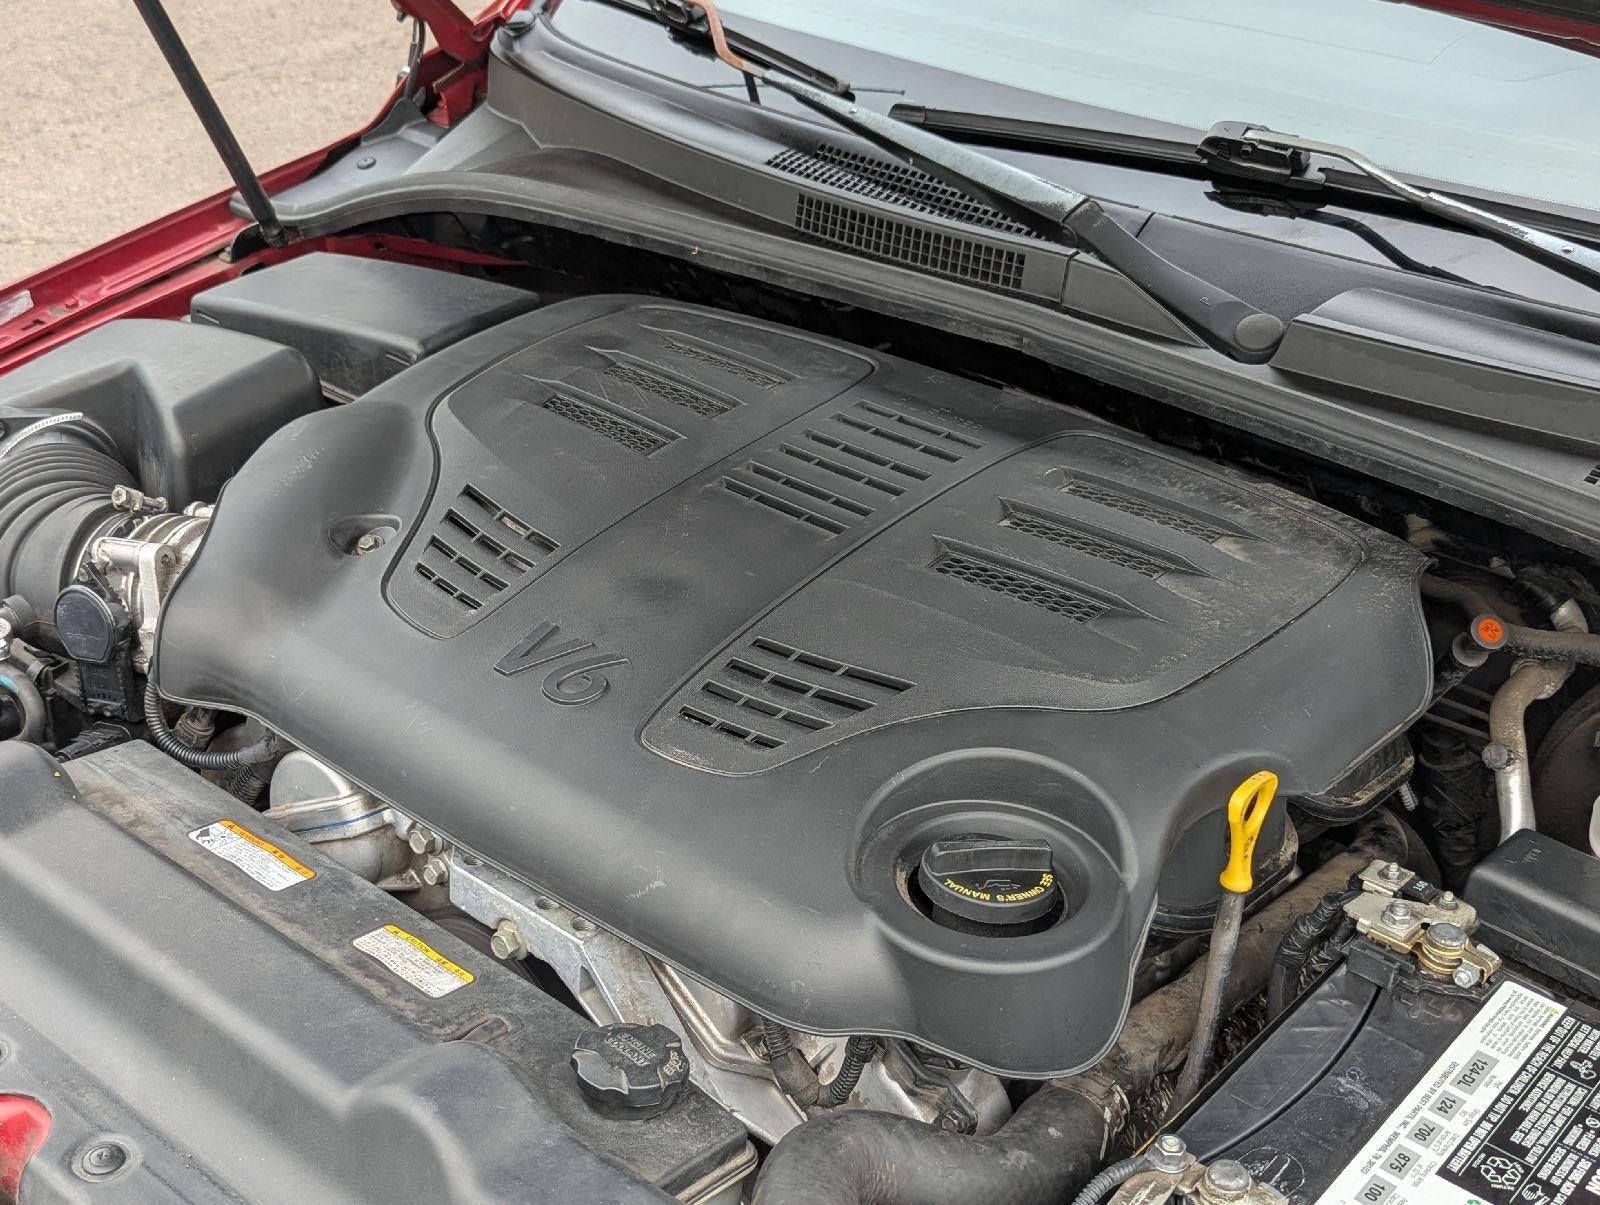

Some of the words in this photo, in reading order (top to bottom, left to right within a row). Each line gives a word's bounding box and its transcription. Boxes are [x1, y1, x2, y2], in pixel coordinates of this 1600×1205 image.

[493, 618, 632, 707] V6
[1039, 873, 1054, 888] SEE
[943, 878, 991, 901] MANUAL
[995, 886, 1045, 902] OWNER'S
[1560, 1015, 1576, 1028] KEEP
[1578, 1023, 1591, 1033] GET
[1548, 1034, 1561, 1043] OF
[1552, 1026, 1568, 1037] OUT
[617, 1032, 657, 1060] ENGINE
[1540, 1041, 1555, 1053] THE
[1566, 1031, 1586, 1049] MEDICAL
[603, 1037, 651, 1067] COOLANT
[1529, 1049, 1549, 1067] REACH
[1560, 1047, 1574, 1058] HELP
[1432, 1060, 1458, 1088] DISTRIBUTED
[1456, 1058, 1488, 1089] 124-DL
[1524, 1064, 1537, 1072] OF
[1536, 1071, 1555, 1089] SERVICE
[1547, 1076, 1566, 1093] MANUAL
[1418, 1093, 1431, 1105] BEST
[1500, 1094, 1513, 1104] DO
[1542, 1091, 1554, 1100] OR
[1404, 1104, 1422, 1121] PARTS,
[1436, 1096, 1457, 1113] 124
[1492, 1101, 1508, 1113] NOT
[1533, 1101, 1547, 1112] NOT
[1545, 1107, 1557, 1115] IN
[1560, 1105, 1573, 1116] FOR
[1479, 1120, 1493, 1130] DO
[1533, 1112, 1553, 1130] VEHICLE
[1413, 1122, 1435, 1141] 700
[1472, 1127, 1488, 1138] NOT
[1509, 1130, 1525, 1143] SEEK
[1376, 1130, 1400, 1153] MEMPHIS,
[1463, 1136, 1480, 1150] OPEN
[1575, 1132, 1595, 1150] FLAMES
[1388, 1152, 1410, 1171] 875
[1524, 1144, 1544, 1163] FOLLOW
[1546, 1146, 1566, 1164] SEVERE
[1359, 1158, 1376, 1174] 38103
[1535, 1162, 1555, 1180] BURNS
[1549, 1176, 1562, 1185] OR
[1559, 1181, 1576, 1194] ACID
[1363, 1182, 1386, 1201] 100
